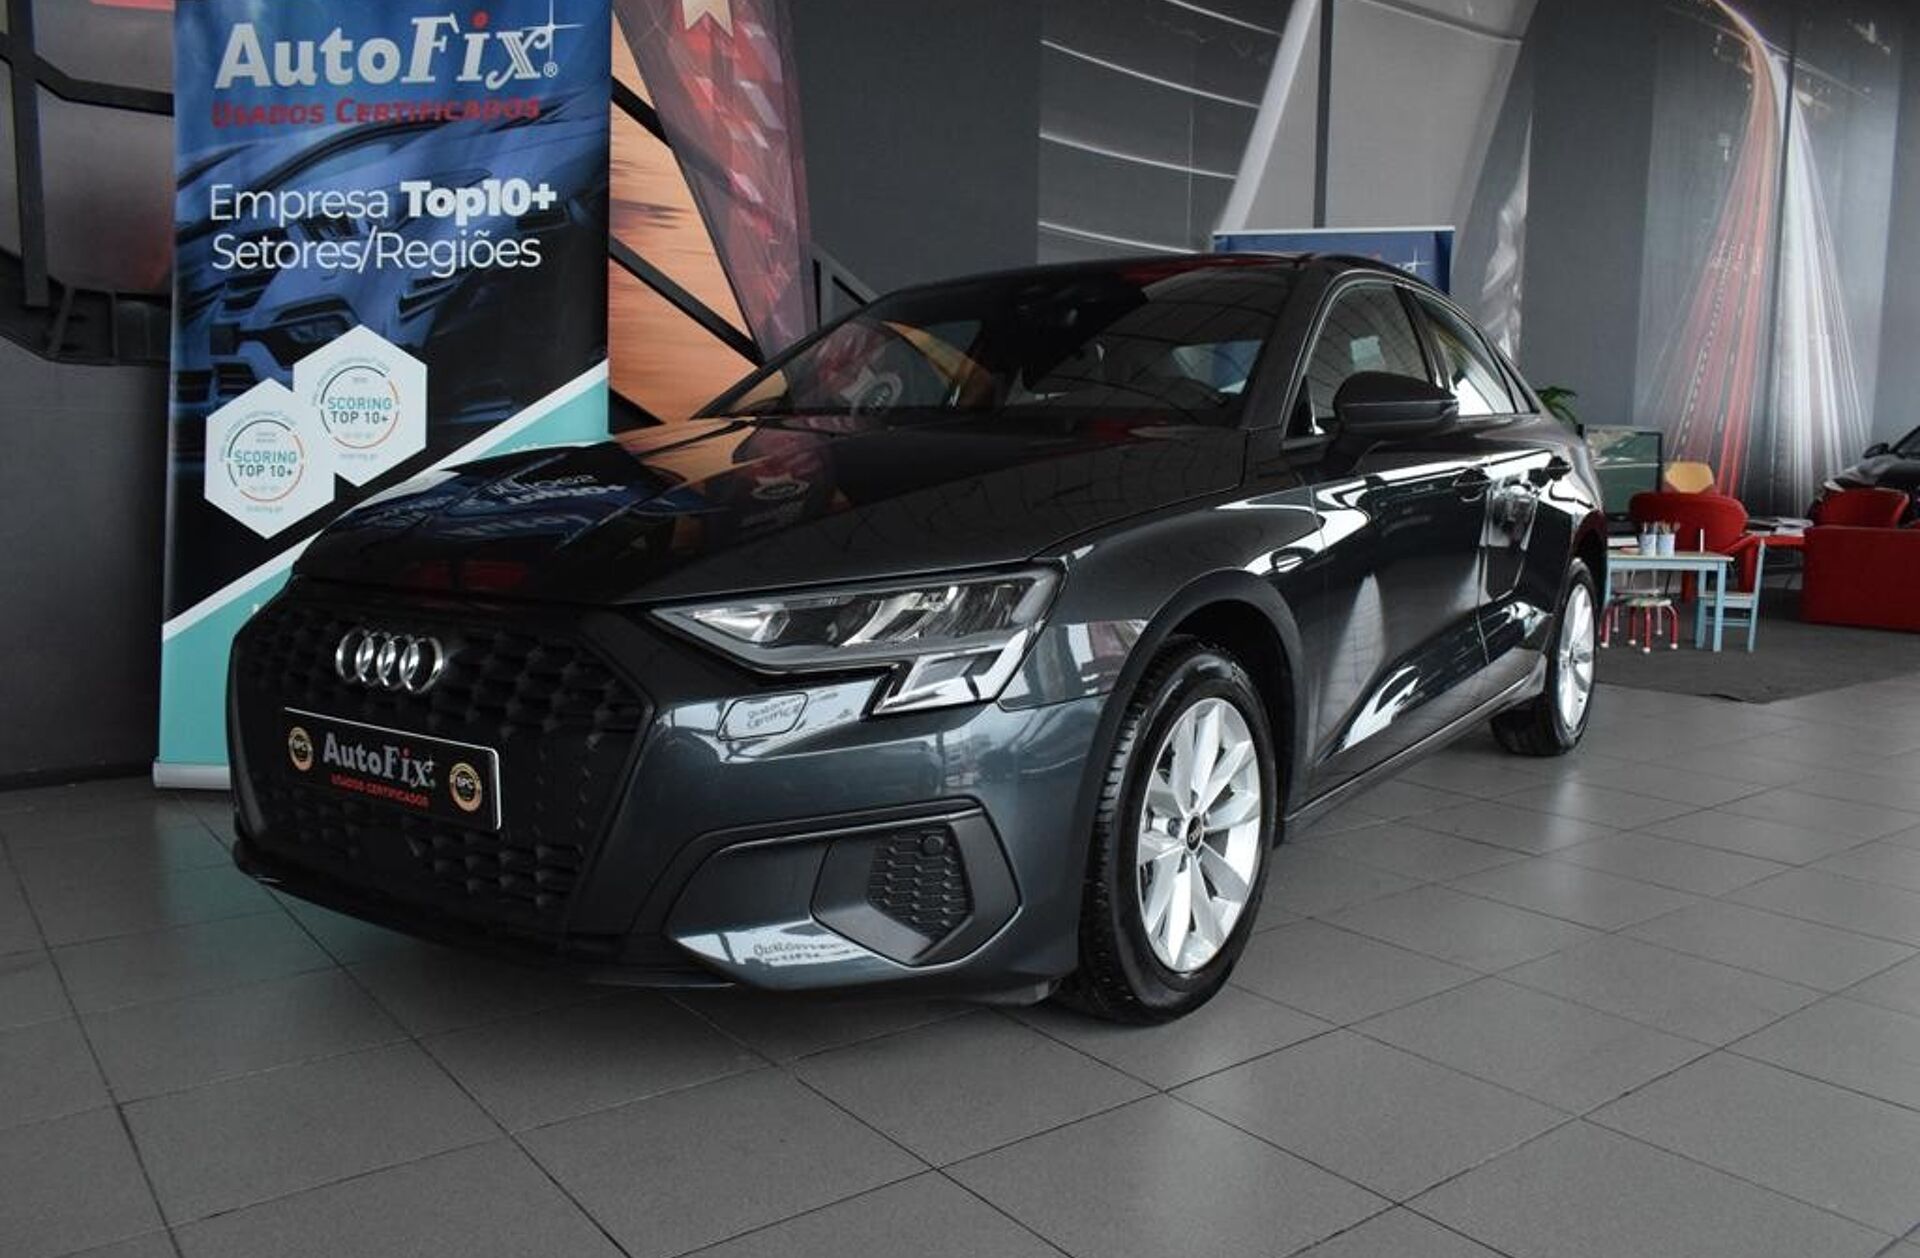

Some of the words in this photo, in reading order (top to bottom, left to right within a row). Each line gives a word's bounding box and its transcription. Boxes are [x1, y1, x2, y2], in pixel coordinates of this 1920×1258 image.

[209, 183, 389, 227] Empresa
[401, 178, 557, 226] Top10+
[212, 226, 541, 277] Setores/Regiões
[327, 397, 392, 410] SCORING
[331, 410, 359, 424] TOP
[364, 410, 389, 424] 10+
[233, 450, 297, 463] SCORING
[238, 464, 264, 477] TOP
[322, 731, 435, 788] AutoFix
